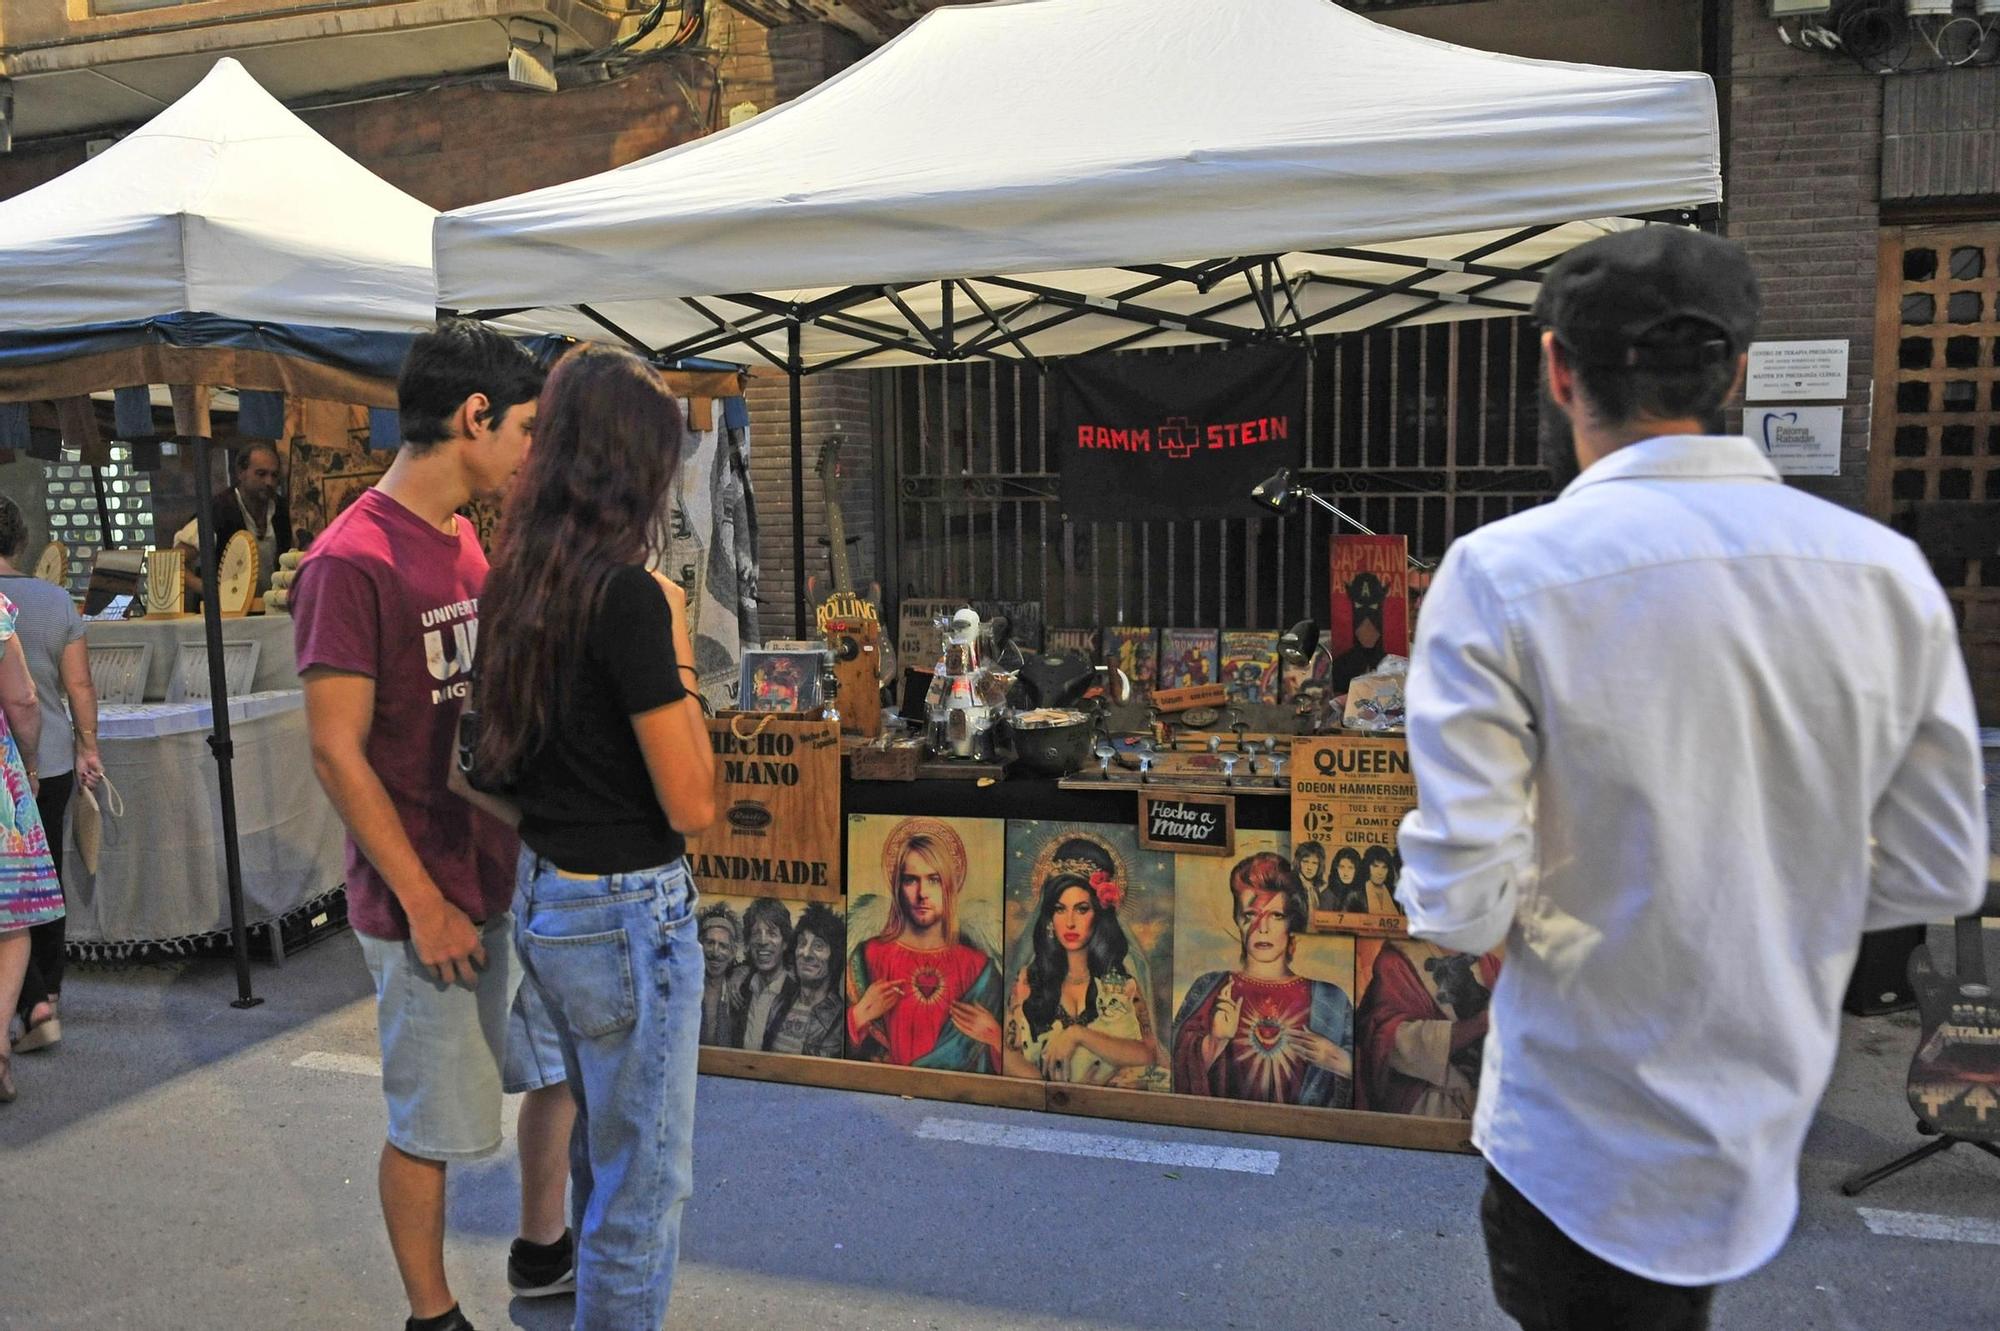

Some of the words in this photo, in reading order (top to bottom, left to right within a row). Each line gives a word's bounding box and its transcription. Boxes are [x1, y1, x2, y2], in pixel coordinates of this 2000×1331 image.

[1078, 425, 1150, 451] RAMM
[1207, 416, 1288, 449] STEIN
[1776, 426, 1809, 435] Paloma
[1333, 543, 1404, 572] CAPTAIN
[816, 600, 877, 627] ROLLING
[902, 603, 927, 618] PINK
[1052, 631, 1096, 650] HULK
[1313, 748, 1409, 776] QUEEN
[724, 761, 799, 786] MANO
[1297, 782, 1336, 794] ODEON
[1150, 801, 1198, 820] Hecho
[1200, 813, 1216, 824] a
[1309, 803, 1329, 812] DEC
[1348, 804, 1367, 813] TUES
[1373, 805, 1387, 813] EVE
[1303, 812, 1334, 832] 02
[1355, 818, 1388, 827] ADMIT
[1307, 833, 1332, 841] 1975
[1345, 832, 1389, 844] CIRCLE
